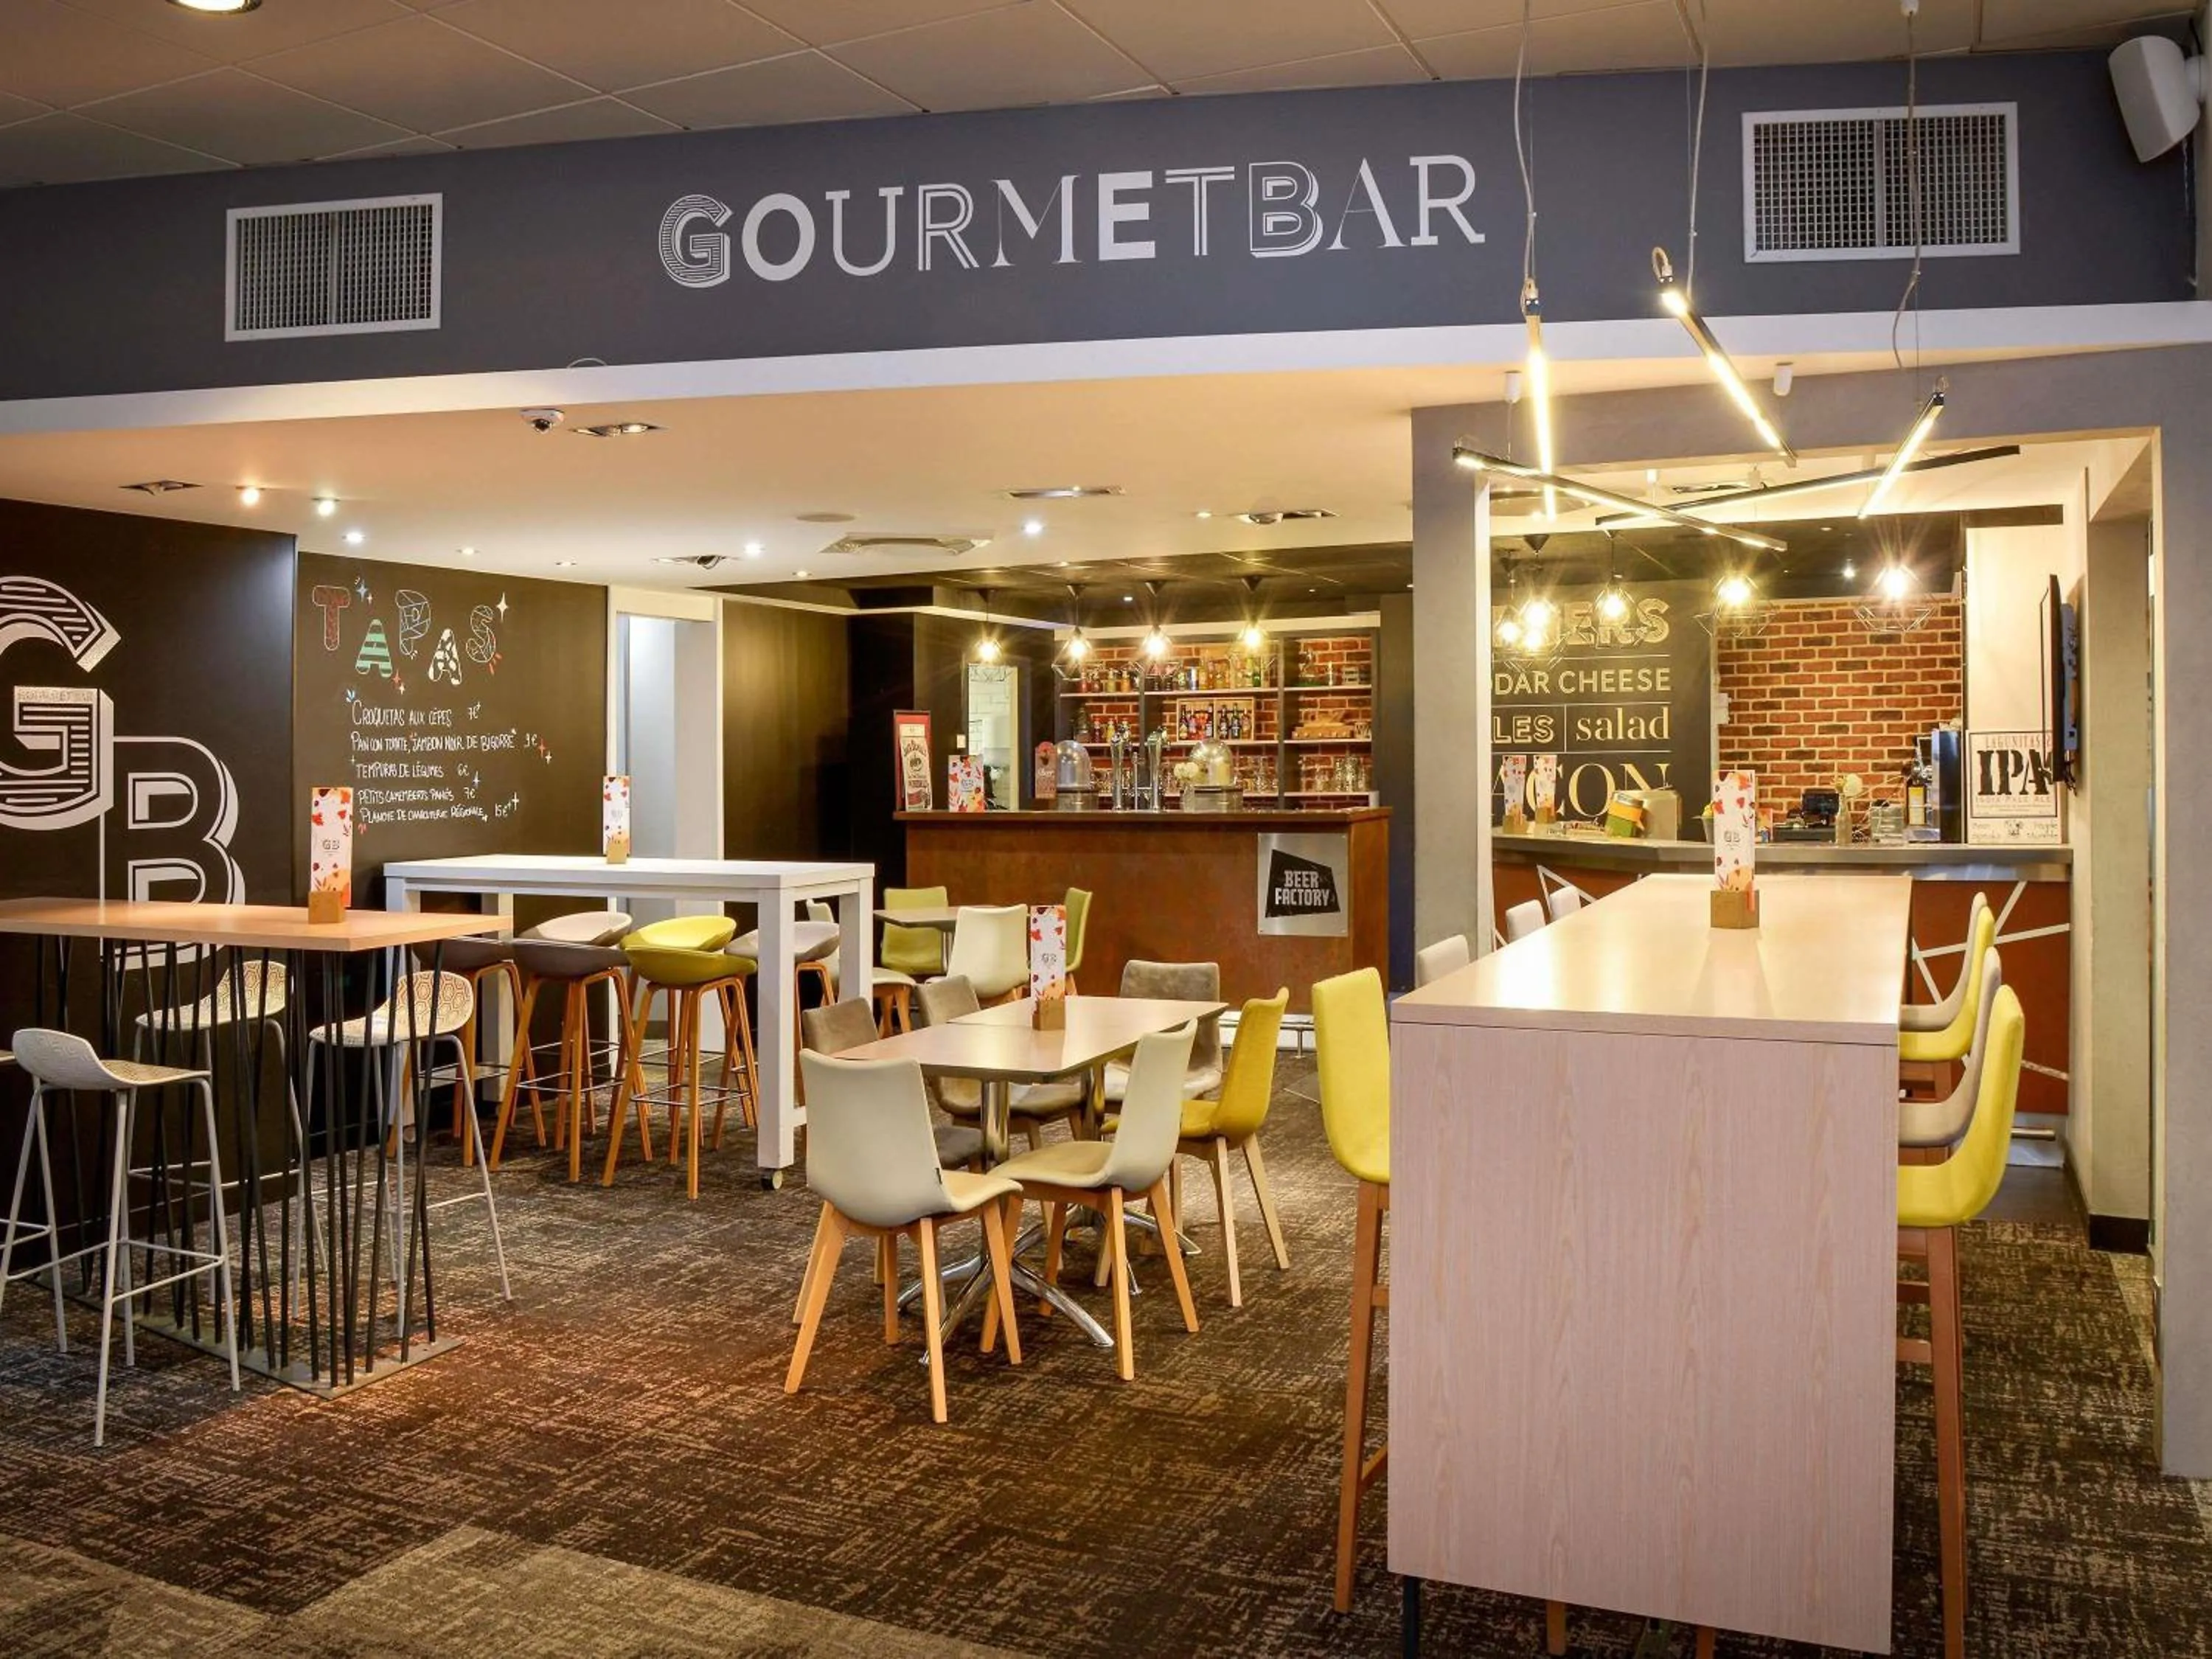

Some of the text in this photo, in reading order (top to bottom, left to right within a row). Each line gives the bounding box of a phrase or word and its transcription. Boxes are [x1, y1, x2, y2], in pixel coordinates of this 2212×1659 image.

[658, 154, 1486, 288] GOURMETBAR
[312, 584, 497, 685] TAPAS
[1558, 667, 1671, 695] CHEESE
[1576, 707, 1669, 742] salad
[466, 735, 478, 750] DE
[398, 763, 411, 778] DE
[1977, 748, 2050, 796] IPA
[1284, 870, 1319, 888] BEER
[1275, 888, 1330, 906] FACTORY
